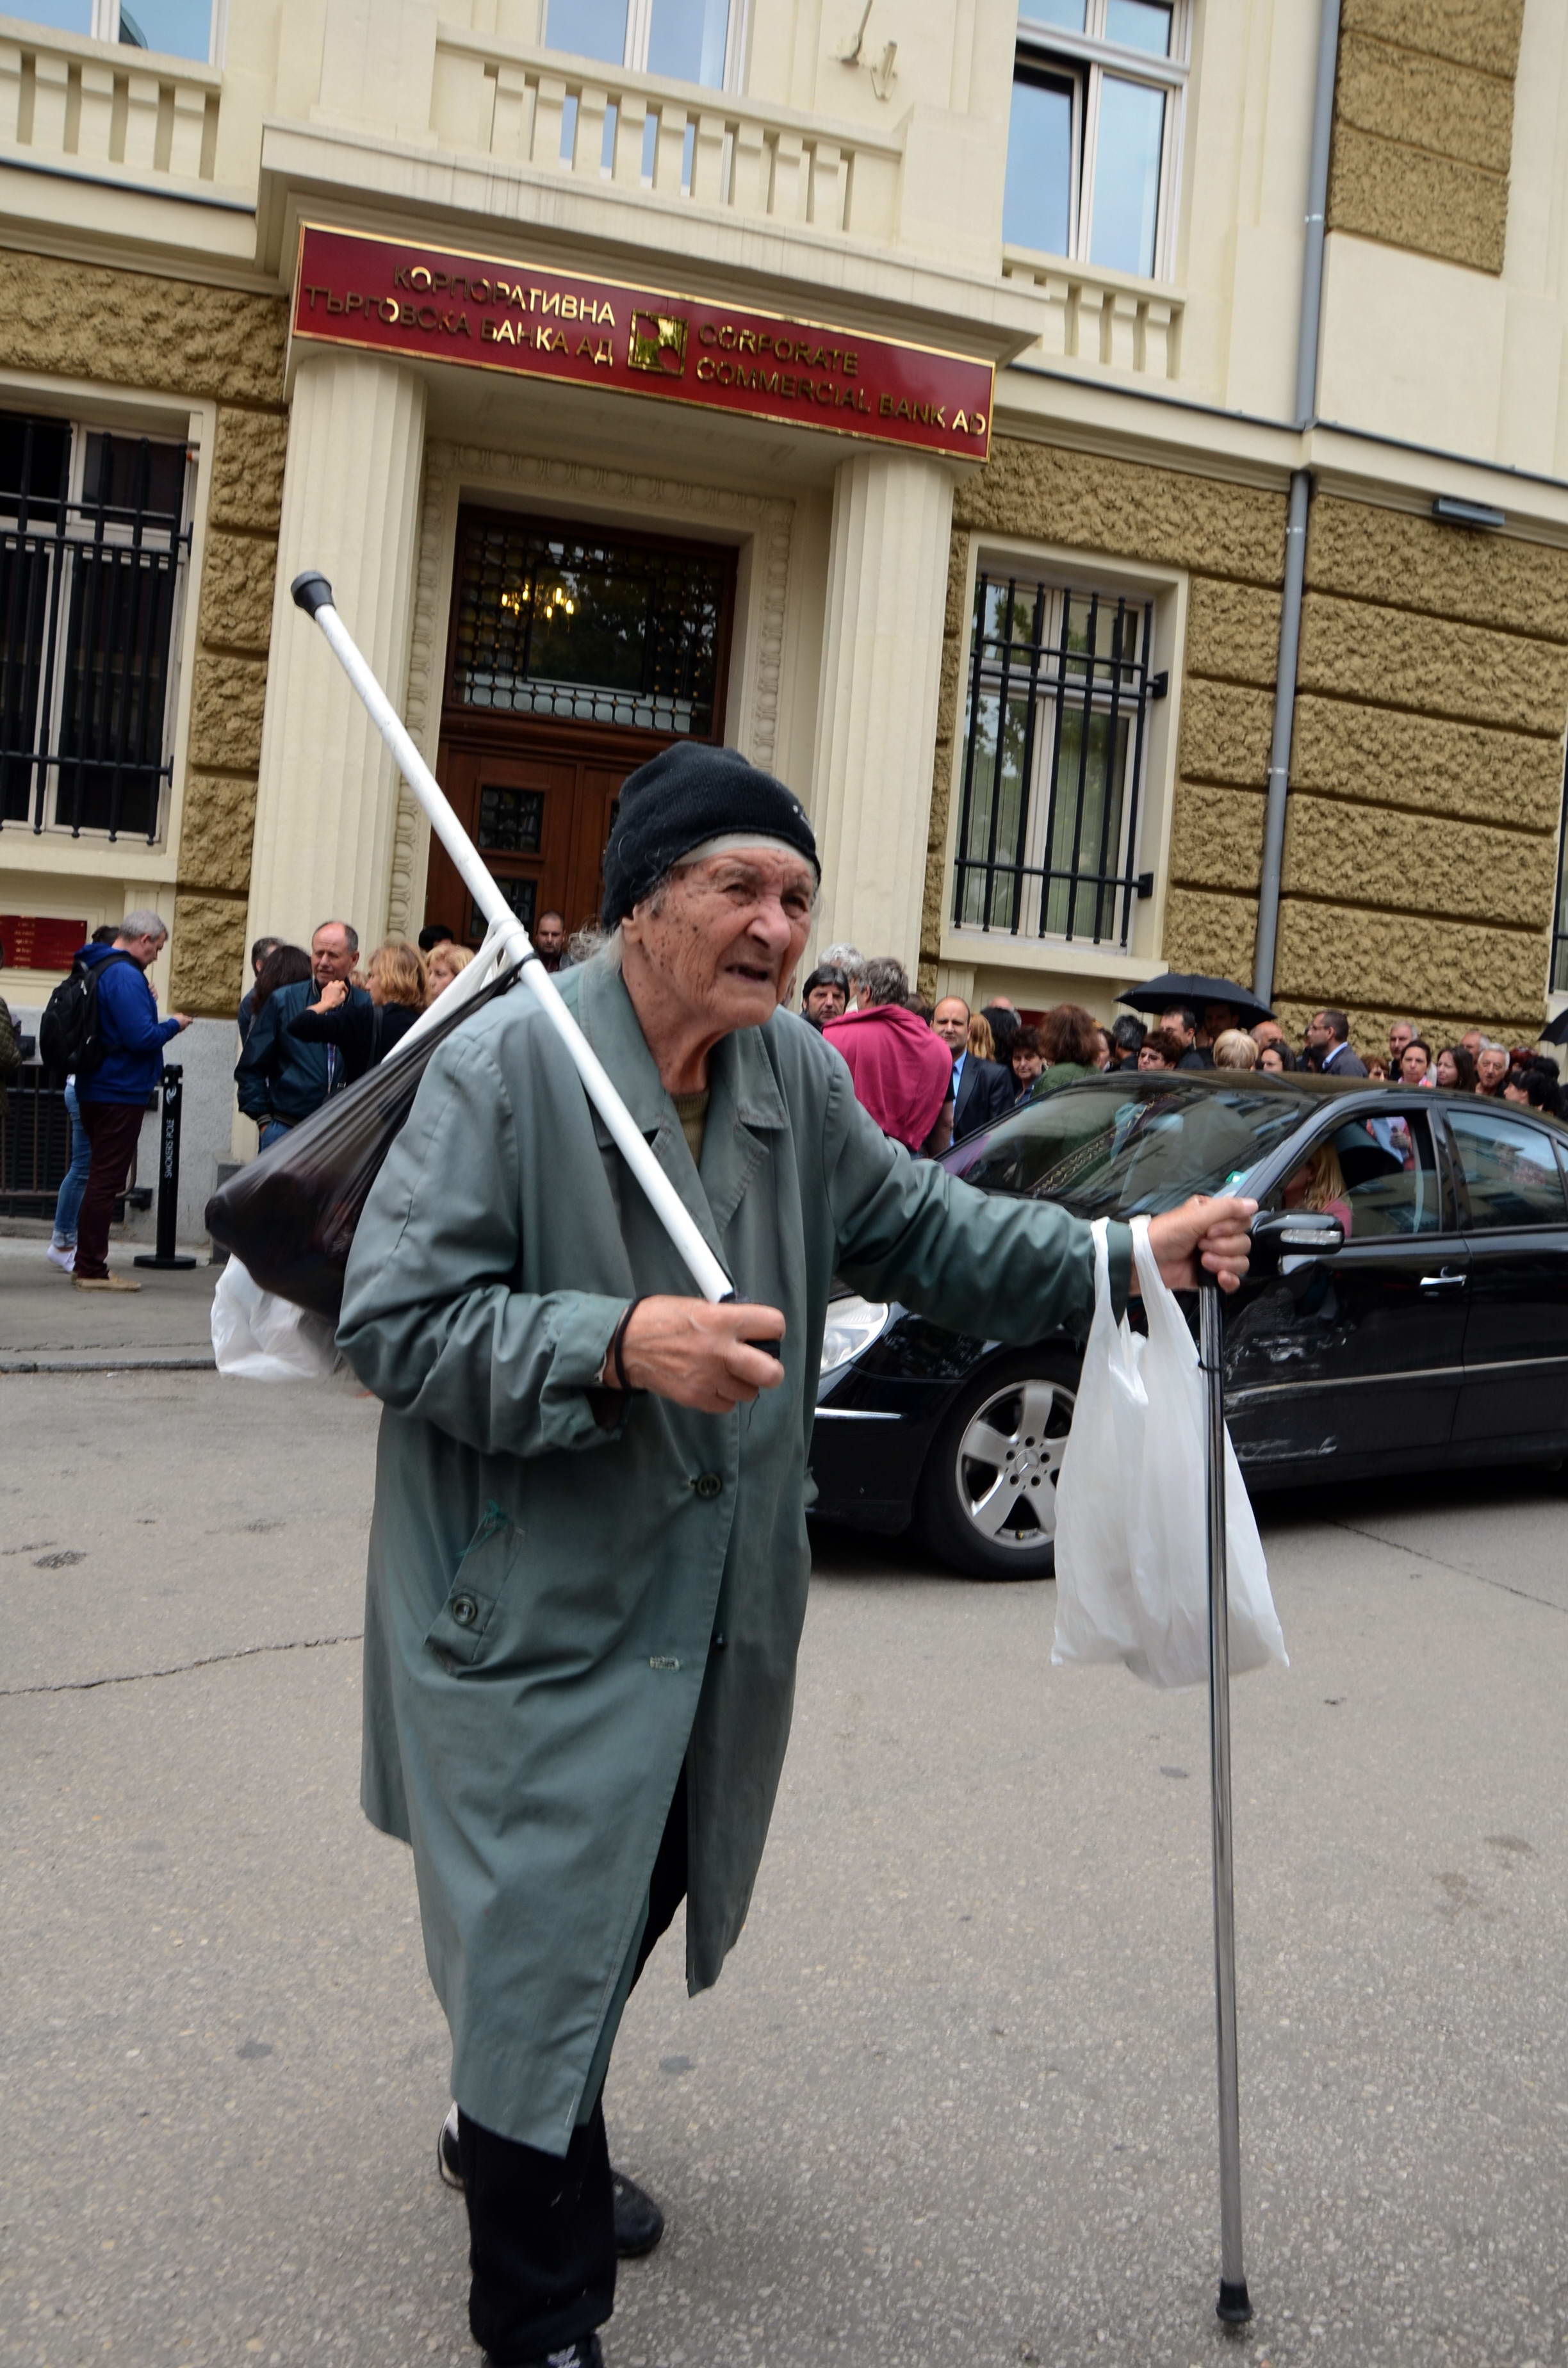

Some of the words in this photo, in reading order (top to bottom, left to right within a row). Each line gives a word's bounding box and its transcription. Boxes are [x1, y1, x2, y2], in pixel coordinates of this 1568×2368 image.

[304, 284, 472, 338] ТЪРГОВСКА
[480, 317, 569, 355] БАНКА
[576, 334, 614, 366] АД
[393, 265, 616, 328] КОРПОРАТИВНА
[699, 322, 859, 376] CORPORATE
[696, 356, 872, 413] COMMERCIAL
[879, 393, 947, 429] BANK
[951, 409, 987, 436] AD
[166, 1118, 174, 1139] POLE
[165, 1141, 174, 1179] SMOKERS
